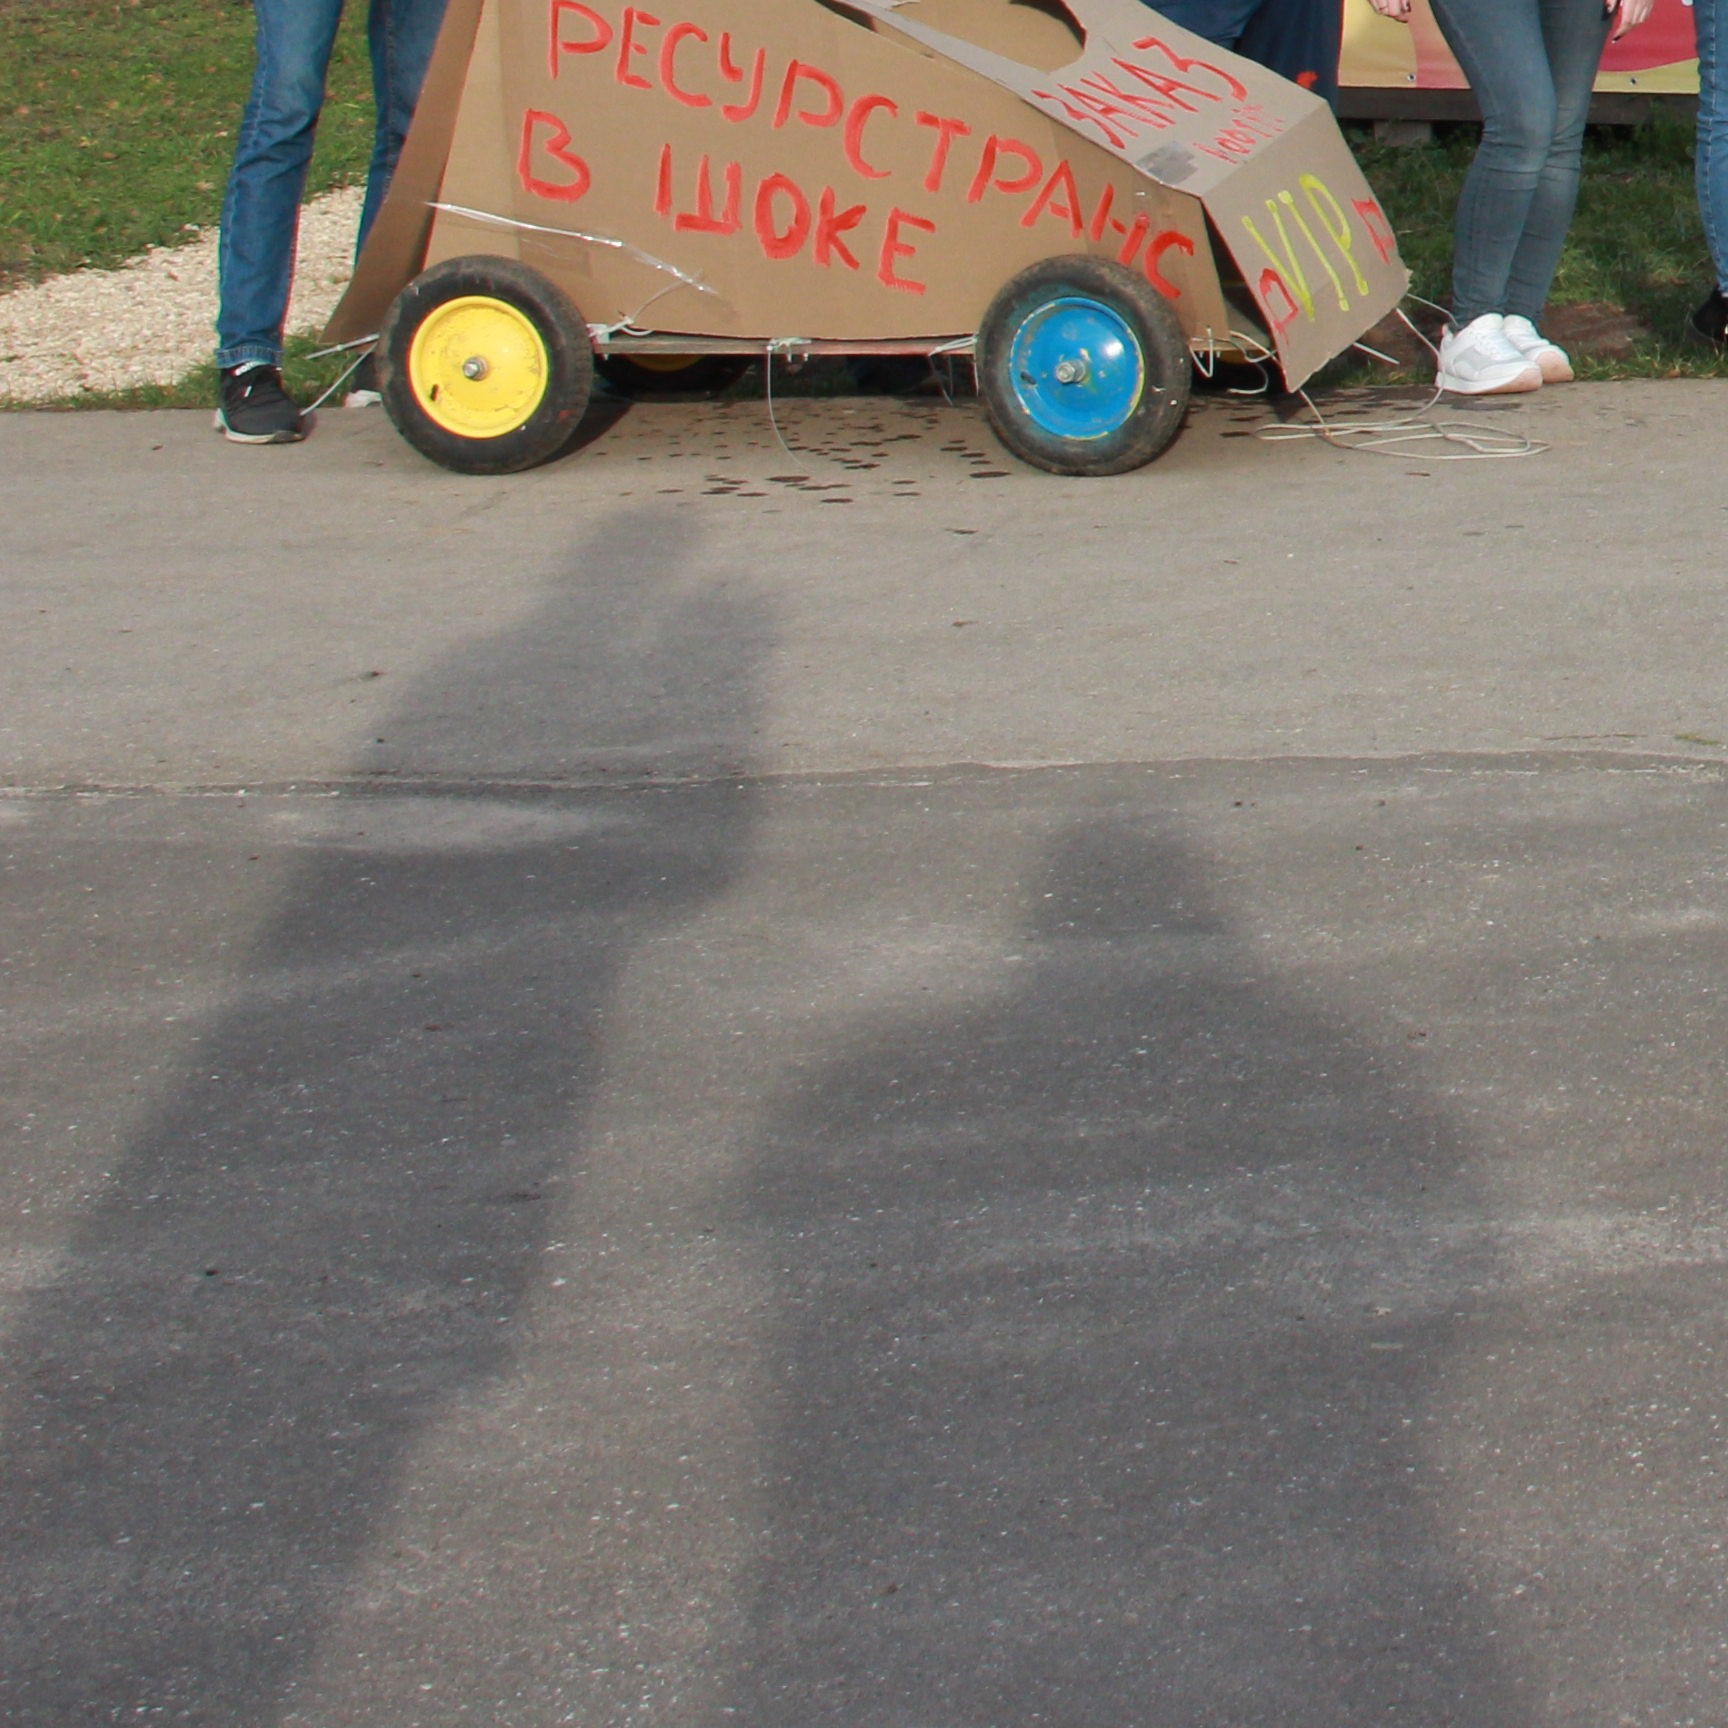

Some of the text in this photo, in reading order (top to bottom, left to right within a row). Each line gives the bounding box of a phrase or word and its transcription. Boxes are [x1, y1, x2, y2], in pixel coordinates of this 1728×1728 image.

[1030, 34, 1248, 150] ЗАКАЗ
[516, 108, 936, 296] В ШОКЕ
[1241, 173, 1370, 322] VIP
